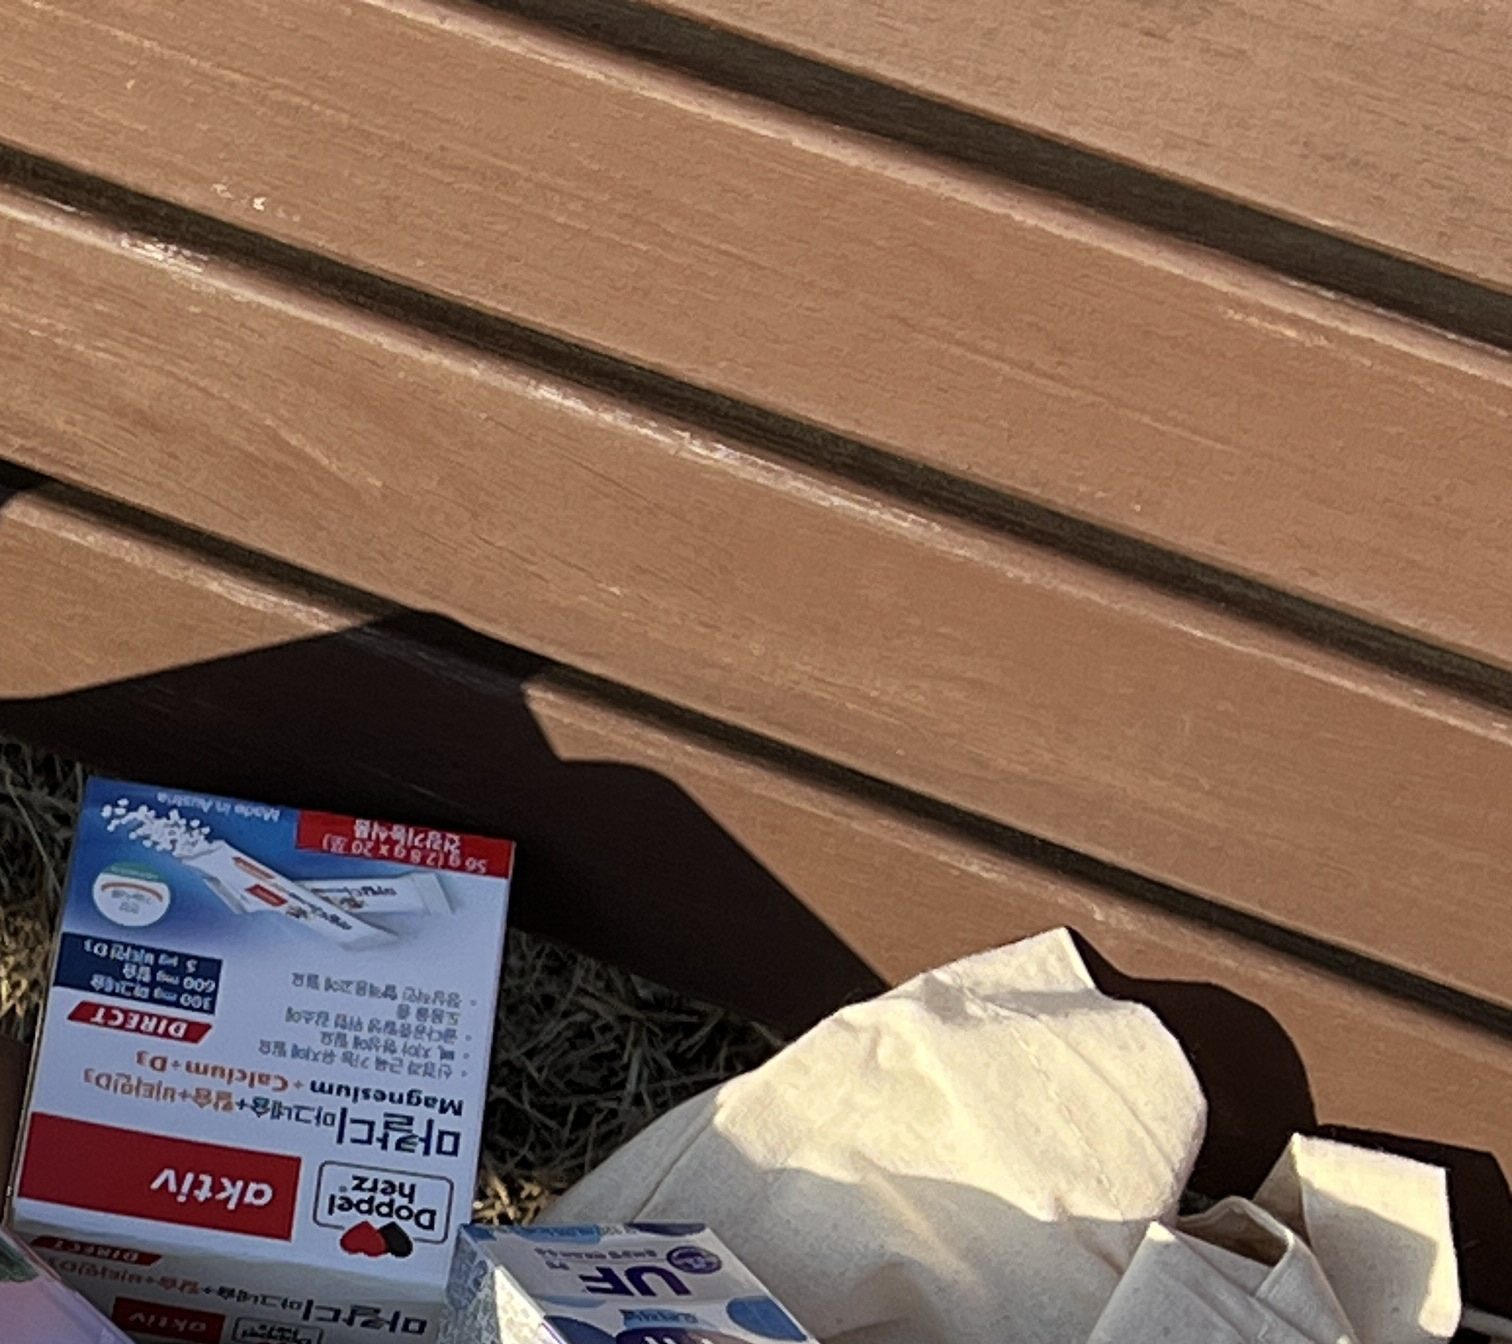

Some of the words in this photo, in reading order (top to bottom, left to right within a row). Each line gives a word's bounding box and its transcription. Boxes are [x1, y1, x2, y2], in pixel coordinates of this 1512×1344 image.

[88, 1004, 188, 1038] DIRECT
[183, 1058, 289, 1093] Calcium
[307, 1073, 464, 1119] Magnesium
[334, 1103, 463, 1162] 마칼디
[147, 1164, 274, 1215] aktiv
[348, 1173, 416, 1204] herz
[325, 1190, 437, 1230] Doppel
[565, 1265, 695, 1297] UF
